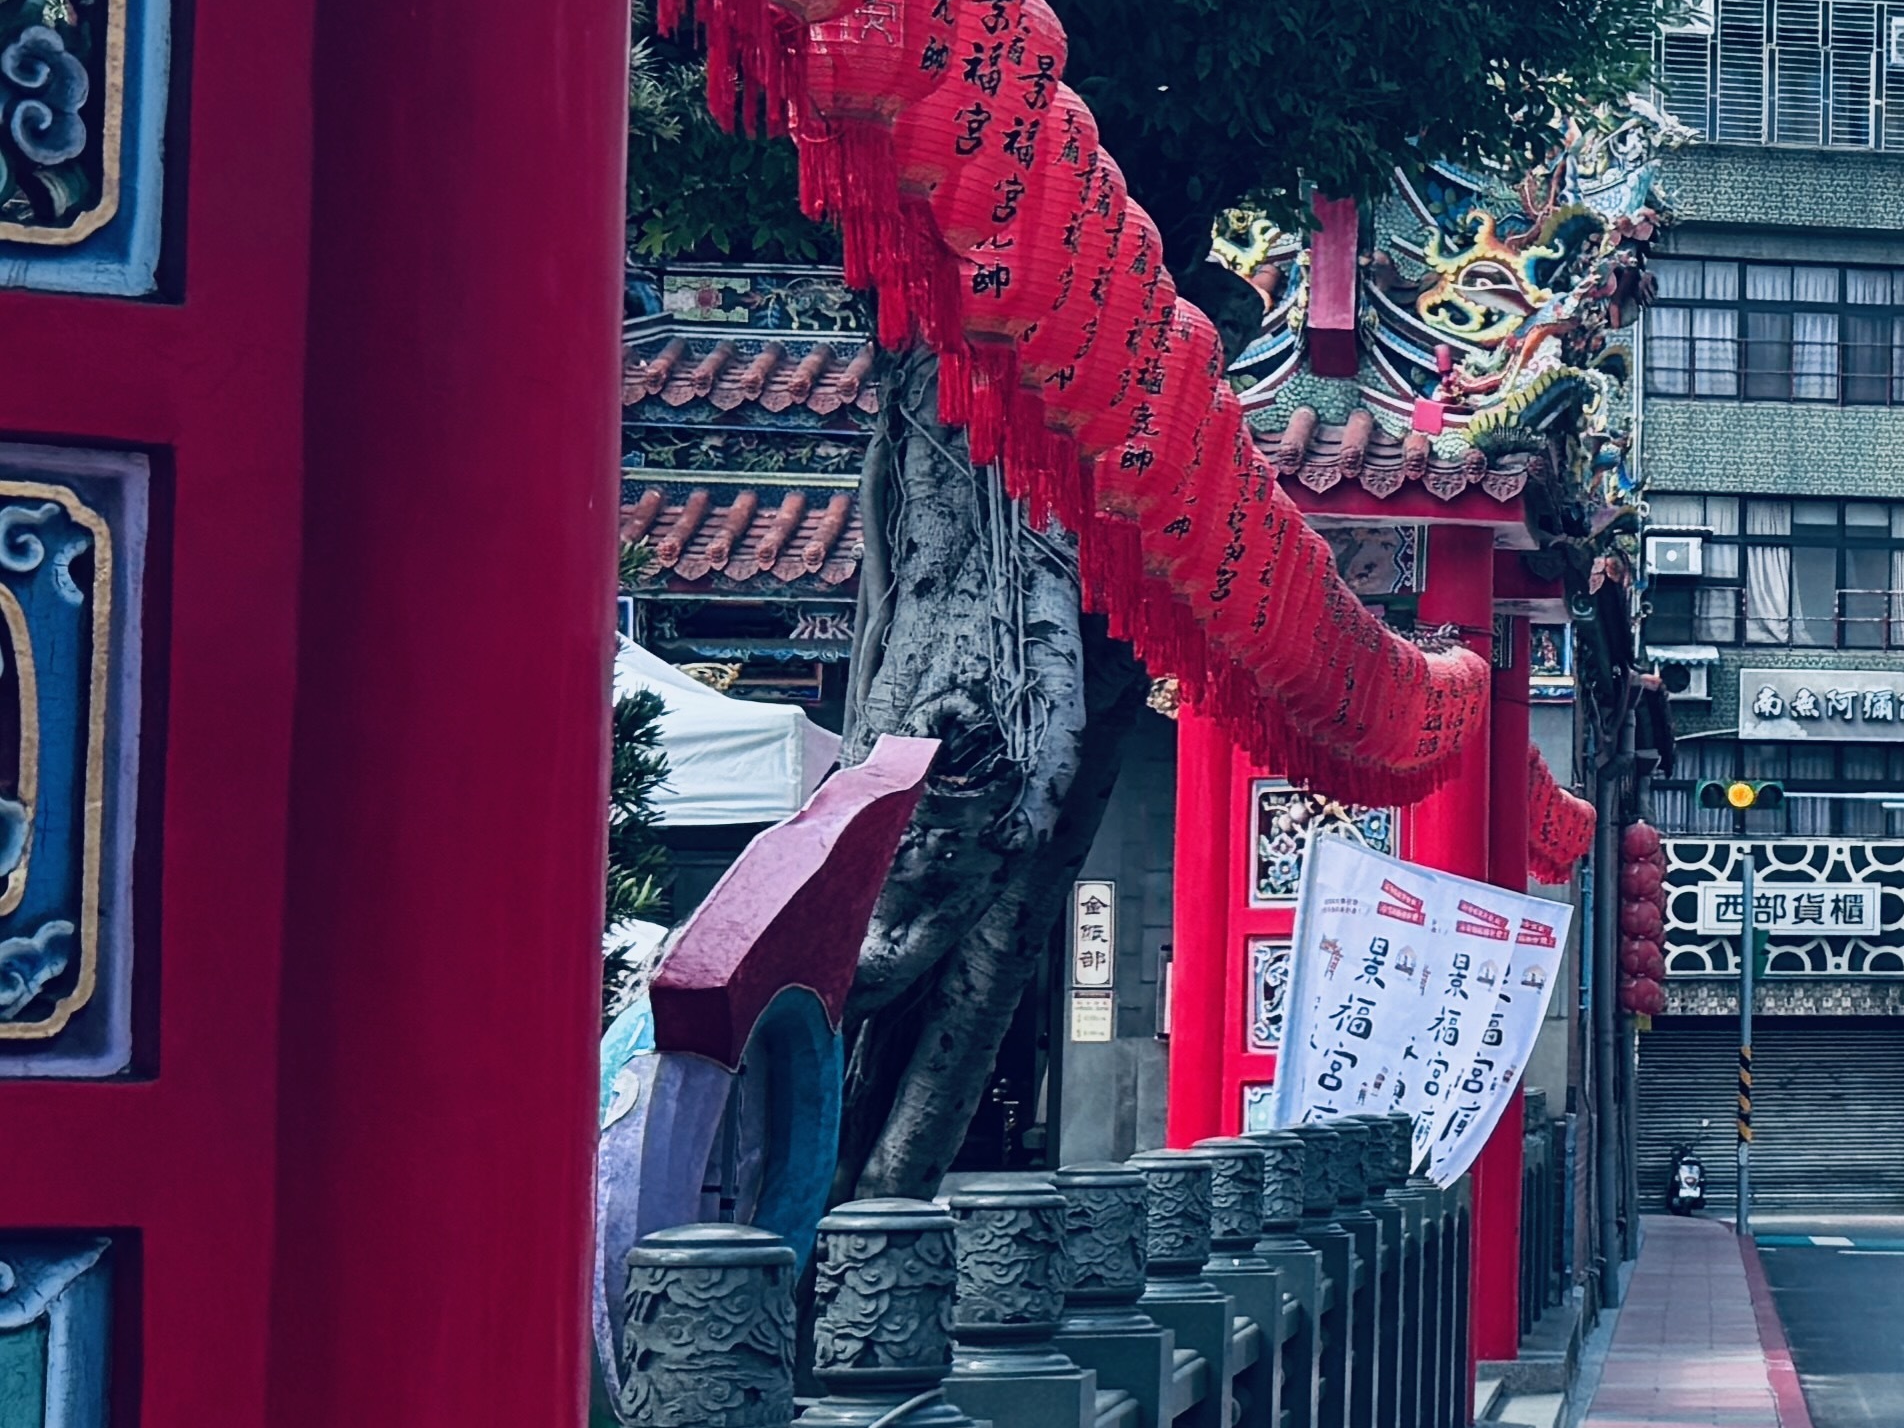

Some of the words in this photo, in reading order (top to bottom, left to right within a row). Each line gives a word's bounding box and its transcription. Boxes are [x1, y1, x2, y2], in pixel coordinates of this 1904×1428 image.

[991, 54, 1056, 225] 景福宮
[1715, 892, 1865, 926] 西部貨櫃
